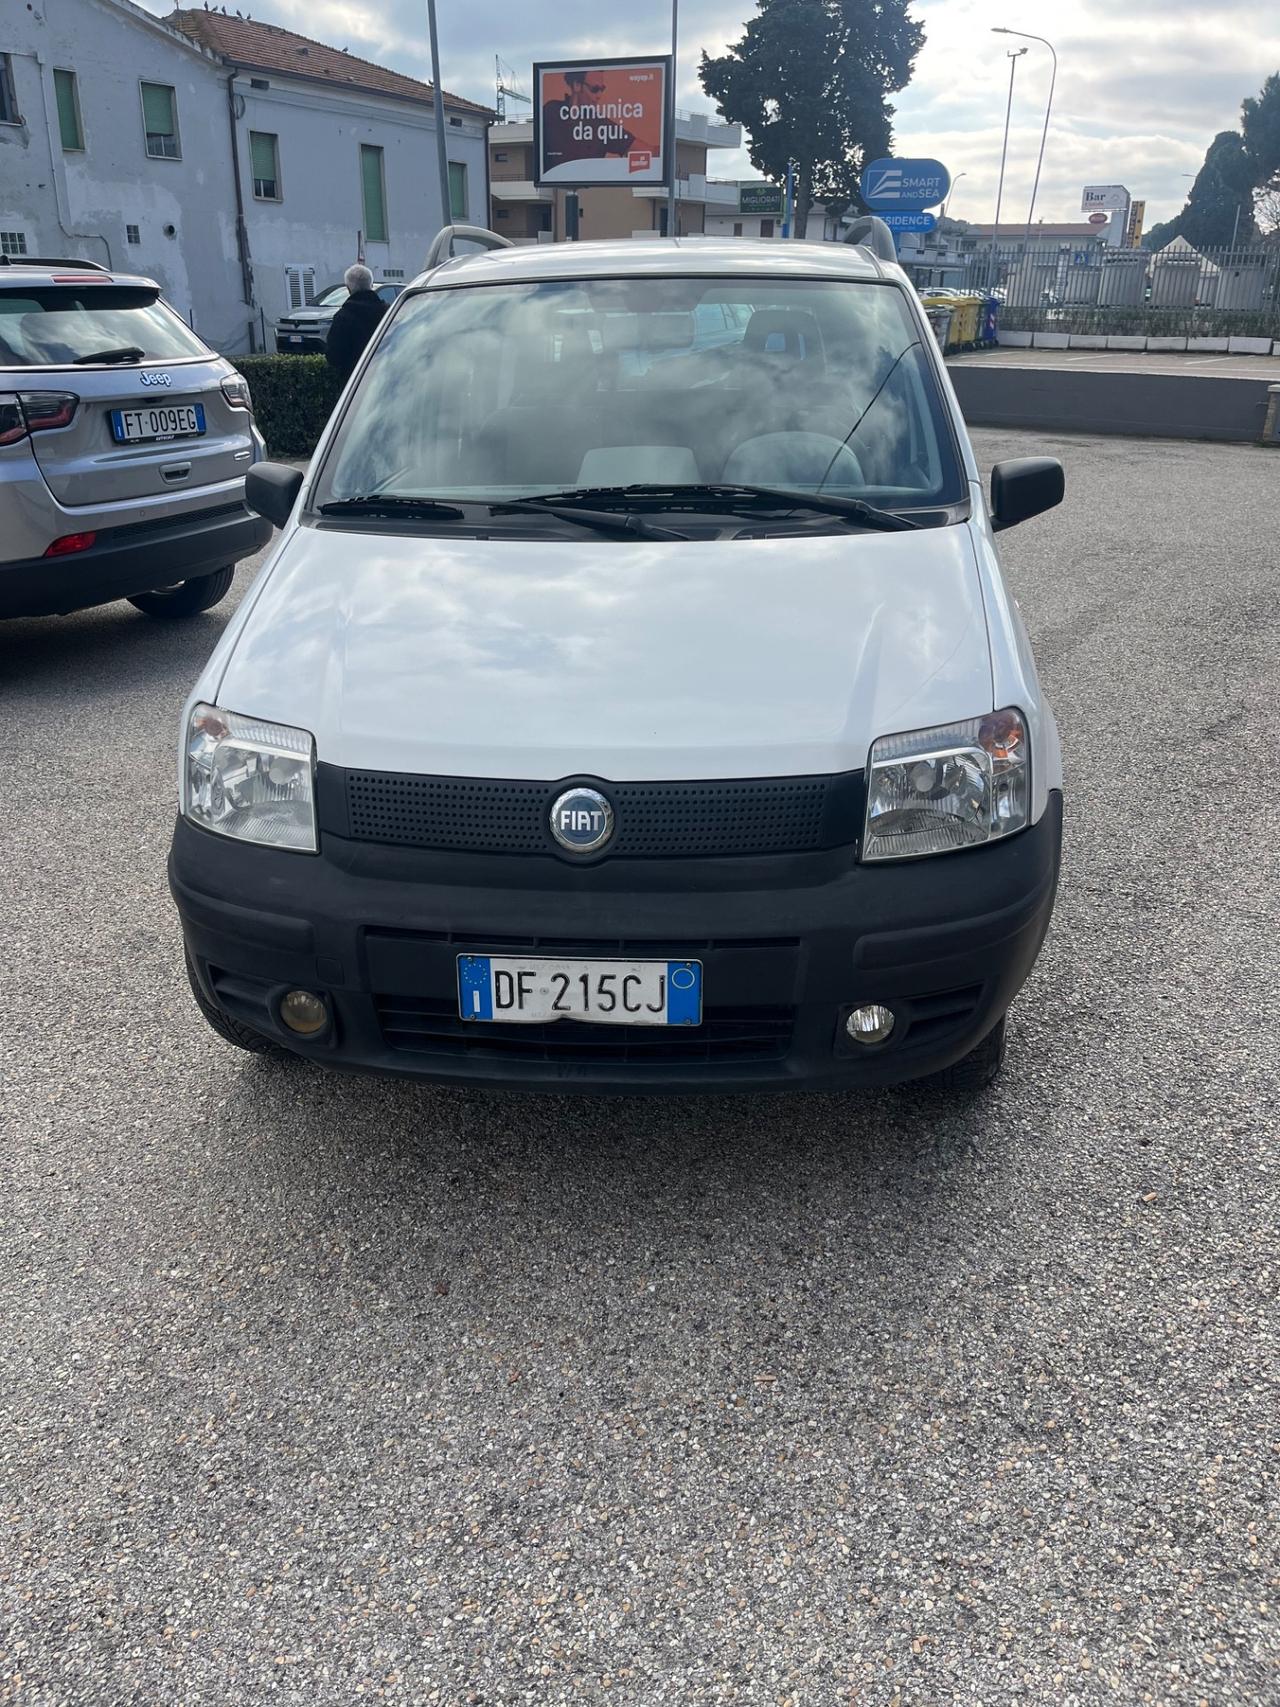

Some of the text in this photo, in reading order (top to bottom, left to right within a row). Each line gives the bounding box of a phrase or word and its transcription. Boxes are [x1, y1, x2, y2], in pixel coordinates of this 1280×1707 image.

[559, 98, 643, 121] comunica
[572, 119, 629, 145] da qui.
[902, 177, 941, 188] SMART
[1085, 191, 1106, 202] Bar
[140, 370, 172, 388] Jeep
[560, 810, 603, 831] FIAT
